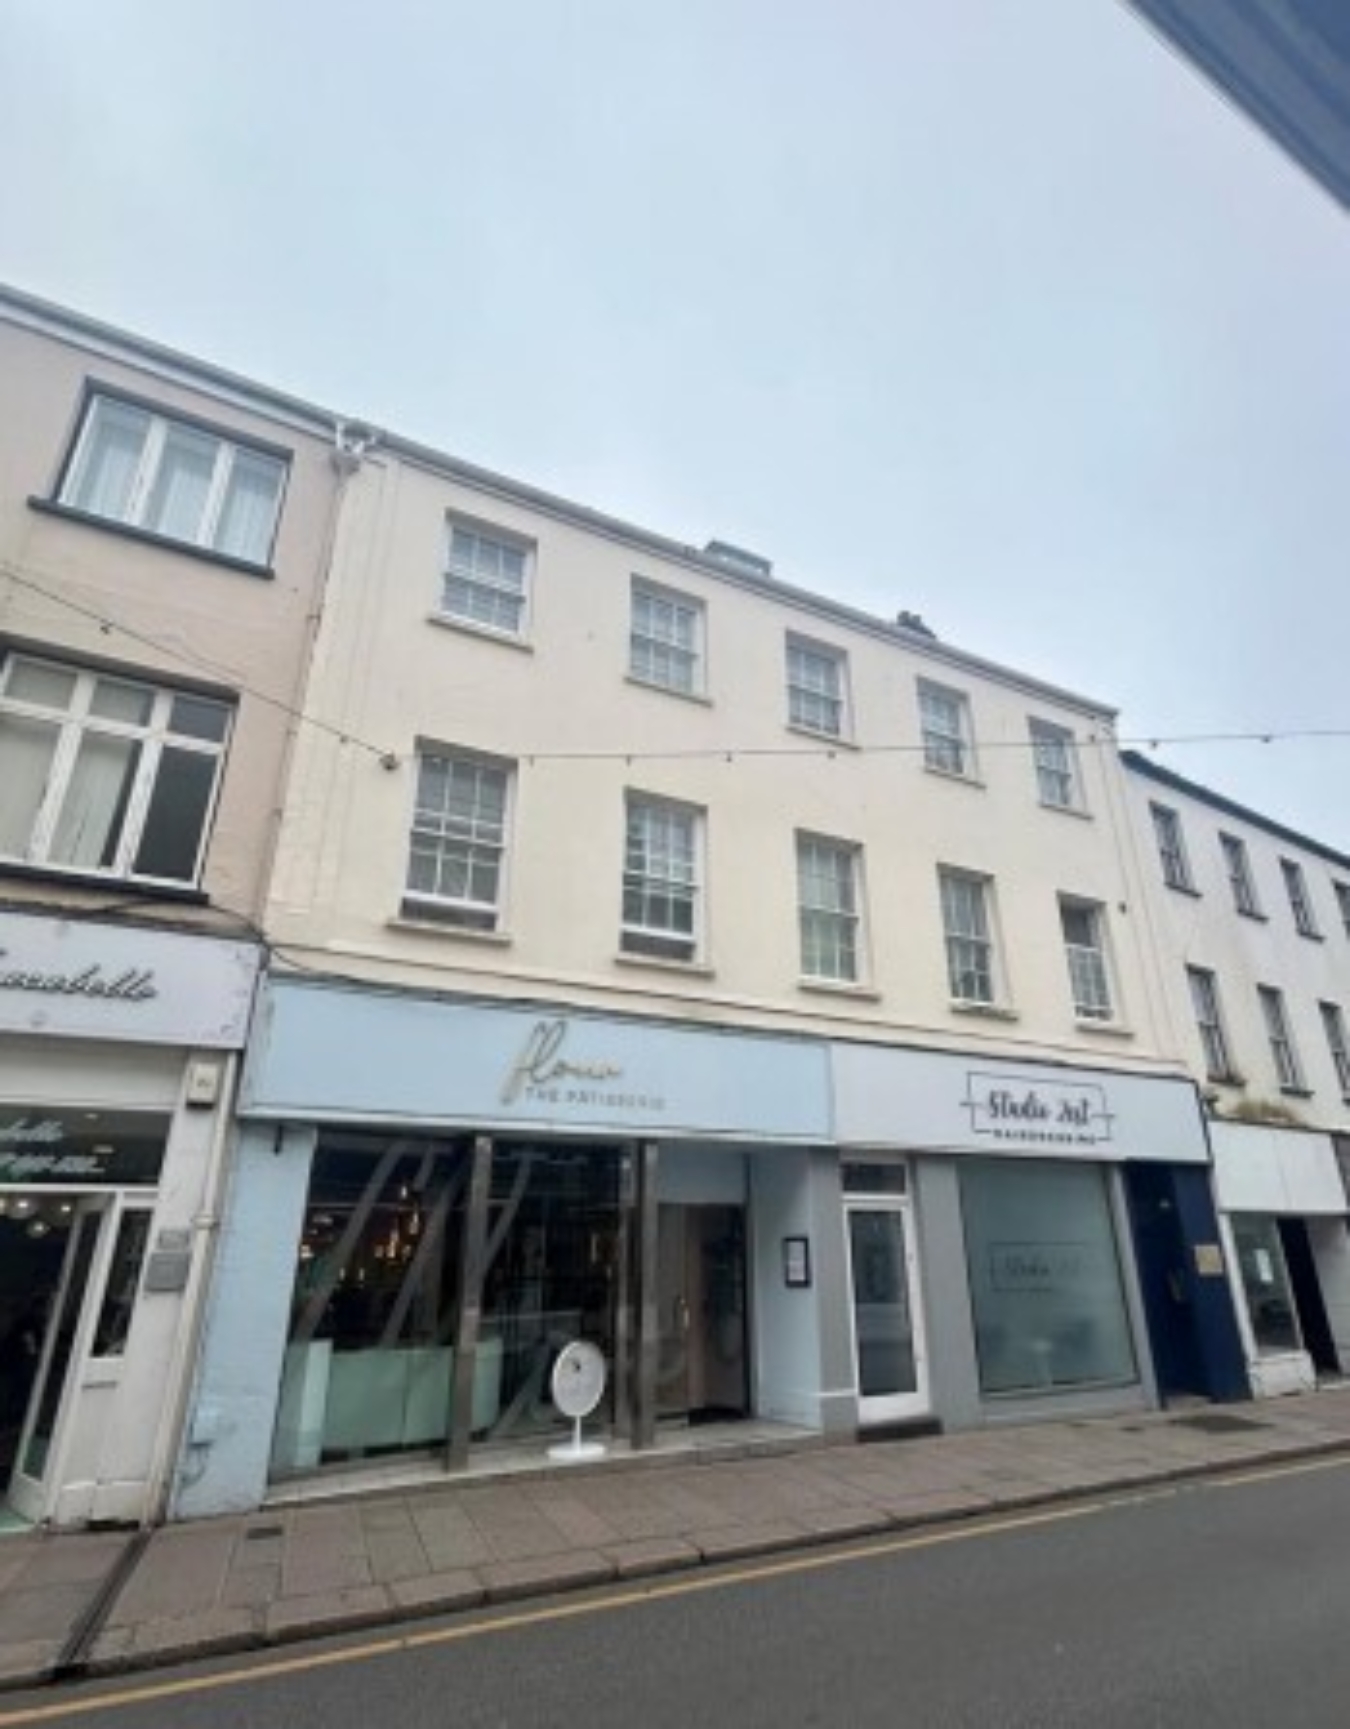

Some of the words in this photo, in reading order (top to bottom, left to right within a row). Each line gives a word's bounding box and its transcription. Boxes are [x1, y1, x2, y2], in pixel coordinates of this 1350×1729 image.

[525, 1086, 559, 1104] THE
[988, 1089, 1051, 1121] Studio
[1056, 1097, 1090, 1127] Art
